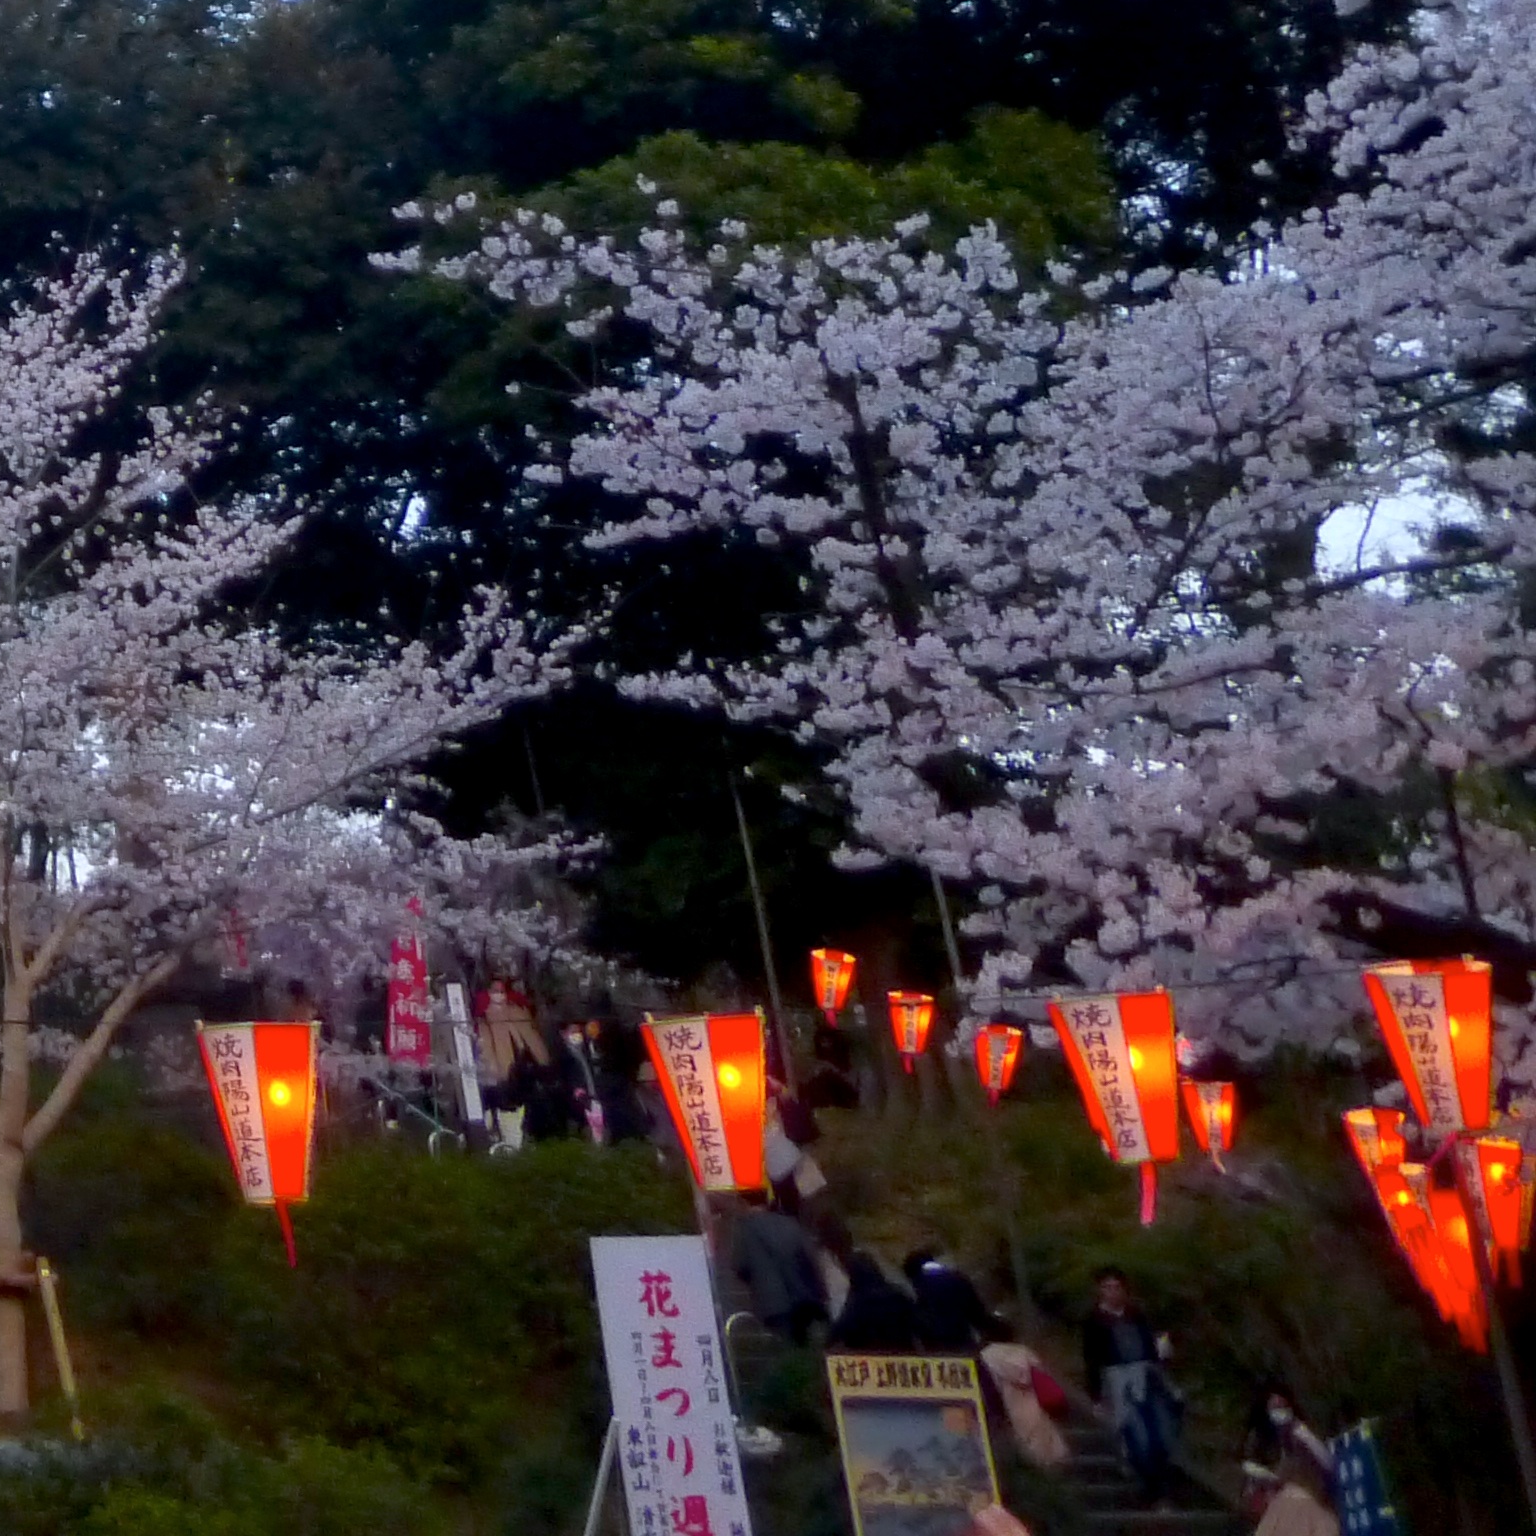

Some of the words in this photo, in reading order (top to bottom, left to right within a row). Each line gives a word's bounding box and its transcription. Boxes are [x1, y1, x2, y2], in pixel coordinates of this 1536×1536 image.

[212, 1033, 263, 1188] 焼肉陽山道本店
[663, 1025, 723, 1176] 焼肉陽山道本店
[1071, 1002, 1139, 1149] 焼肉陽山道本店
